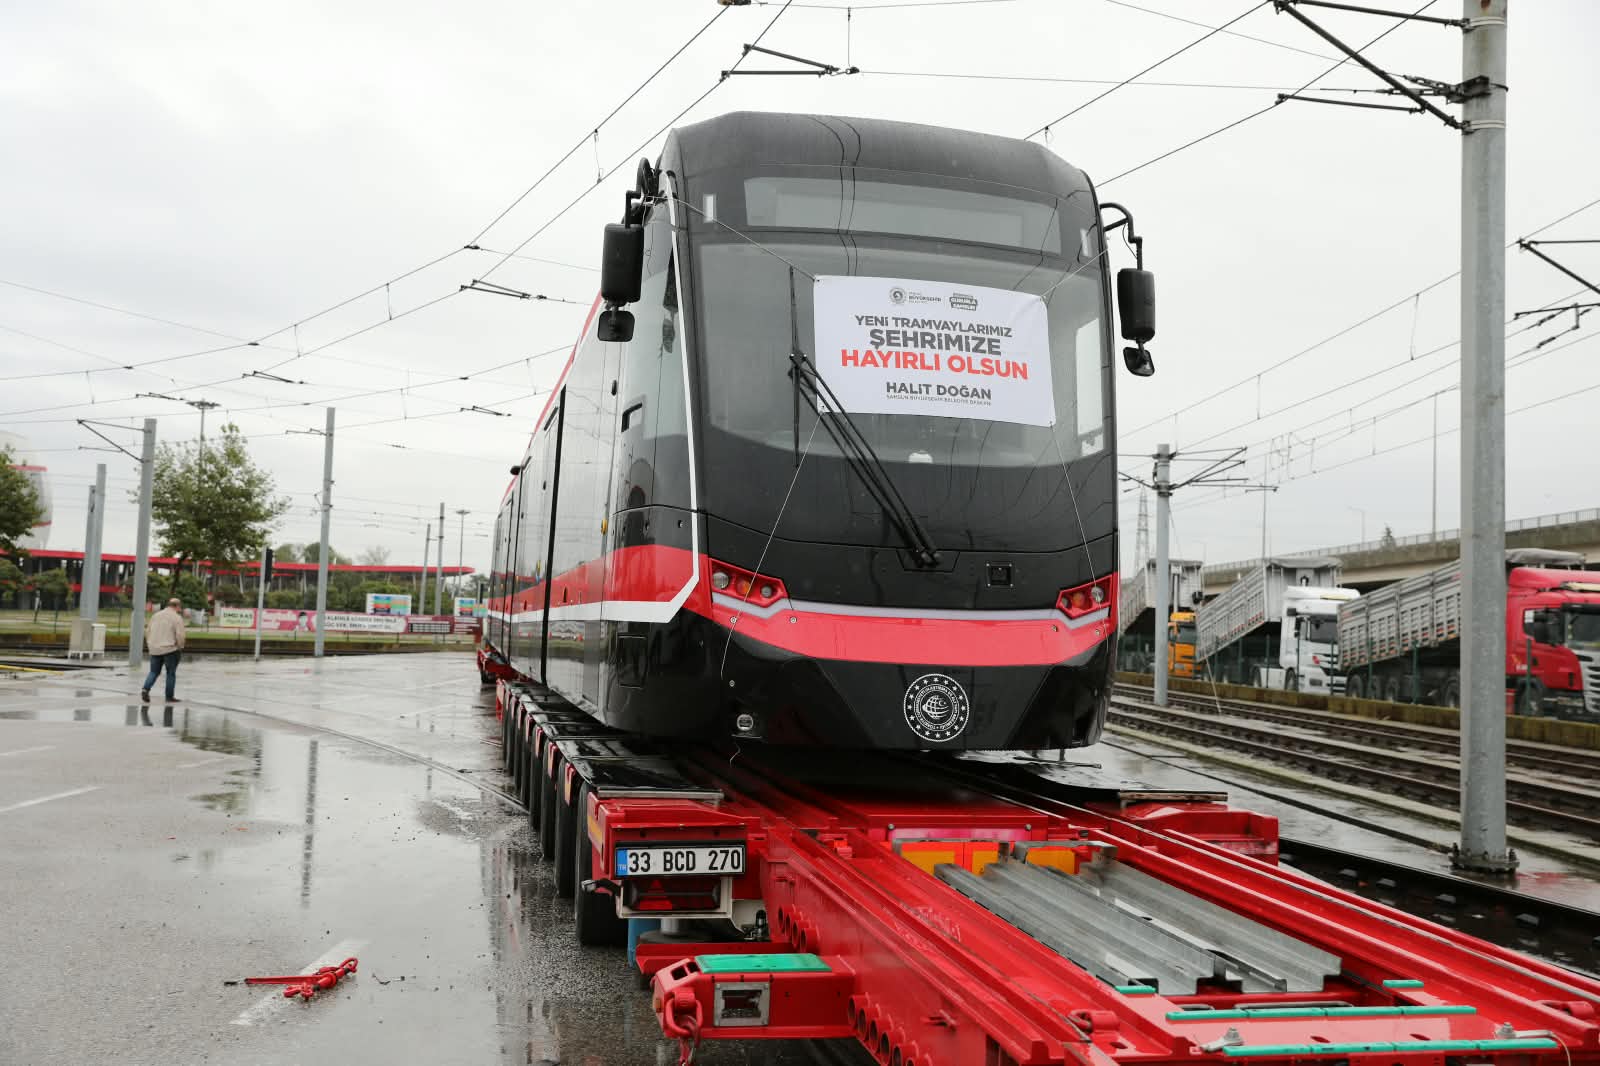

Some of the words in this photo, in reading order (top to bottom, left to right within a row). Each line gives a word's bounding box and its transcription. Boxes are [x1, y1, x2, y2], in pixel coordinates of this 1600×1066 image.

[855, 315, 889, 327] YENİ
[892, 317, 1012, 338] TRAMVAYLARIMIZ
[869, 329, 1002, 356] ŞEHRİMİZE
[841, 349, 941, 371] HAYIRLI
[947, 355, 1028, 380] OLSUN
[886, 382, 932, 395] HALİT
[936, 384, 992, 400] DOĞAN
[629, 851, 651, 872] 33
[663, 851, 696, 872] BCD
[708, 849, 741, 870] 270
